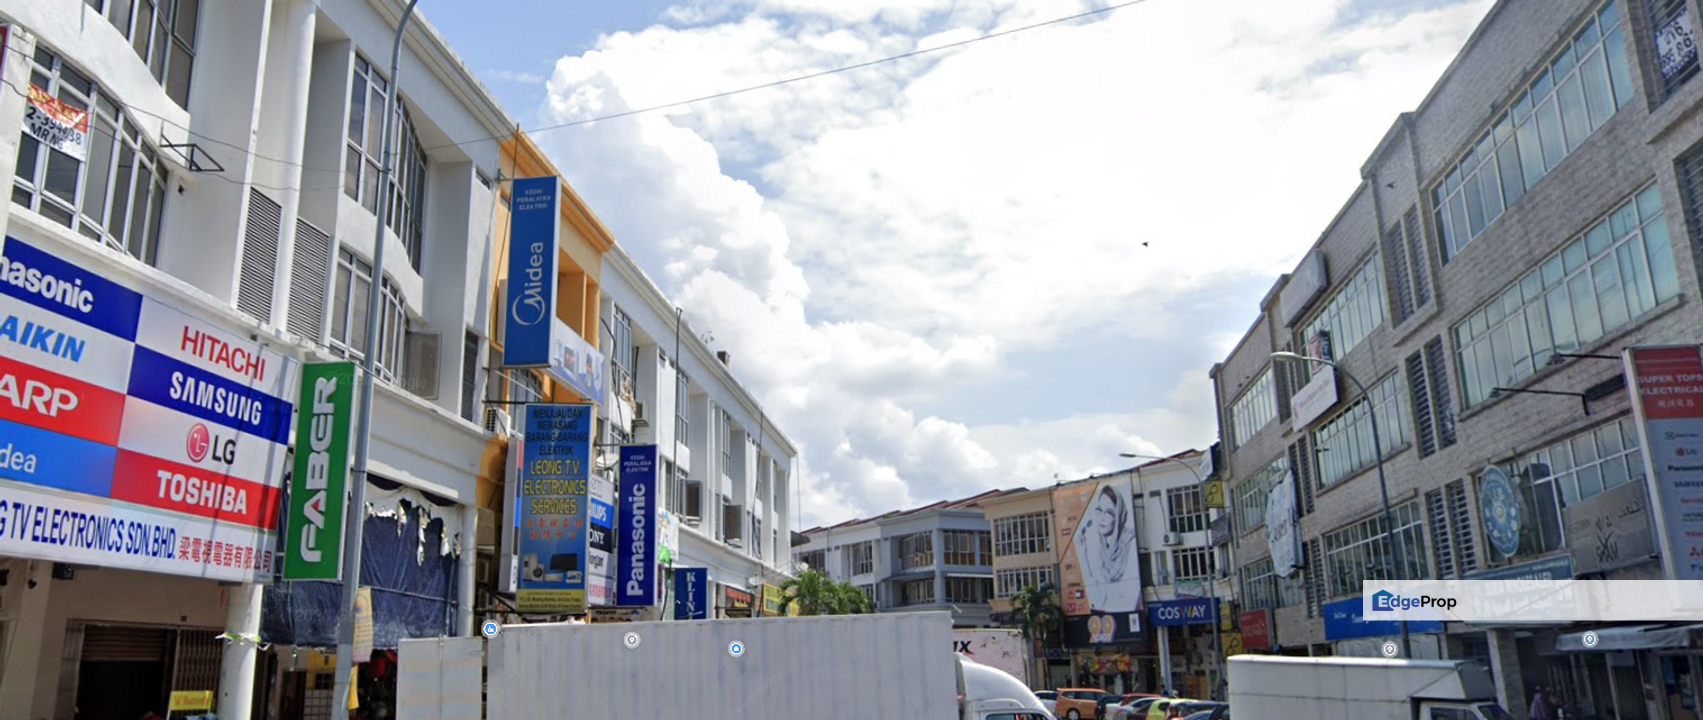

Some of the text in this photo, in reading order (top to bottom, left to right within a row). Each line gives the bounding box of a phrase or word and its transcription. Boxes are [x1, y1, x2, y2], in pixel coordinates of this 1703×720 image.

[520, 242, 545, 316] Midea
[181, 325, 265, 382] HITACHI
[169, 371, 262, 425] SAMSUNG
[212, 435, 236, 465] LG
[301, 376, 338, 563] FABER
[531, 460, 562, 475] LEONG
[157, 469, 248, 515] TOSHIBA
[524, 479, 587, 495] ELECTRONICS
[531, 498, 577, 515] SERVICES
[10, 502, 32, 540] TV
[31, 505, 125, 553] ELECTRONICS
[626, 482, 646, 597] Panasonic
[1157, 604, 1206, 620] COSWAY
